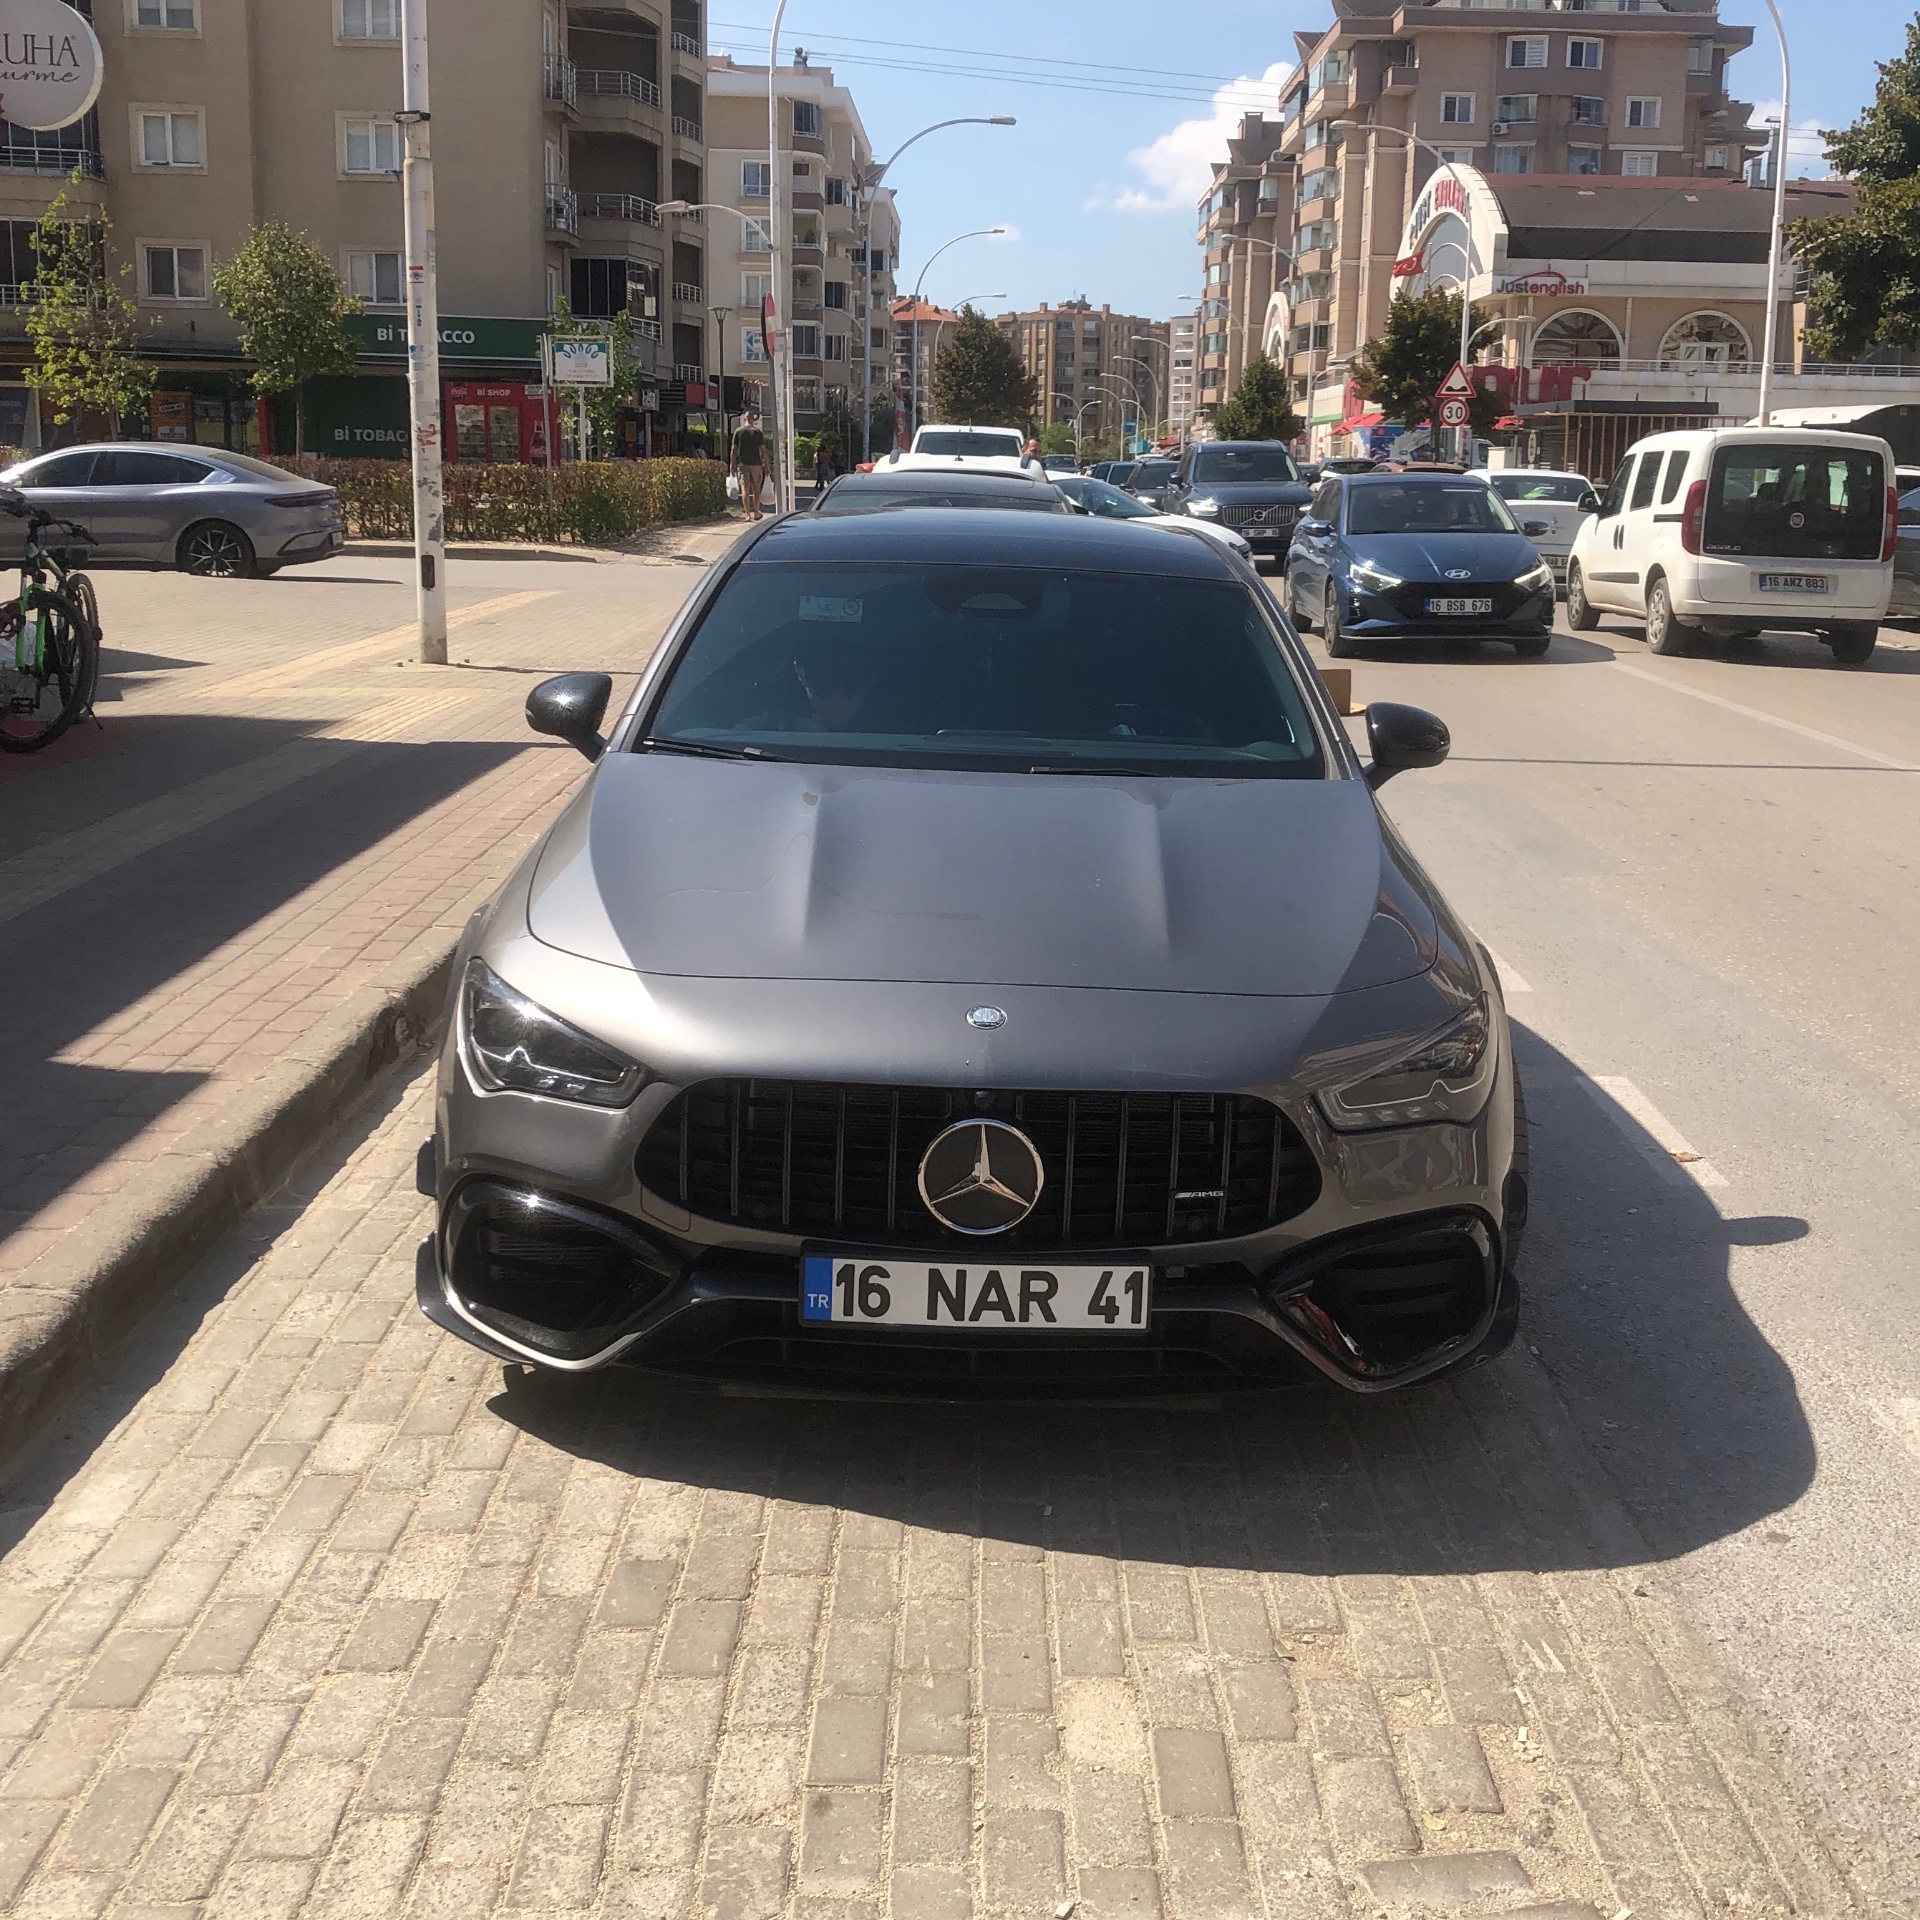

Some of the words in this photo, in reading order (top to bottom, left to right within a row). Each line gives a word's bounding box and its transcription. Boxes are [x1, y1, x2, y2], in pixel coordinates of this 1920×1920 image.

[0, 33, 80, 67] UHA
[0, 70, 80, 83] urme
[1445, 406, 1463, 419] 30
[353, 429, 408, 442] TOBAC
[1768, 576, 1780, 587] 16
[1805, 578, 1825, 589] 883
[1431, 600, 1441, 611] 16
[1446, 600, 1466, 611] BSB
[1472, 600, 1490, 611] 676
[1190, 1190, 1224, 1198] AMG
[836, 1263, 891, 1318] 16
[926, 1267, 1059, 1323] NAR
[1087, 1270, 1144, 1325] 41
[807, 1293, 829, 1309] TR
